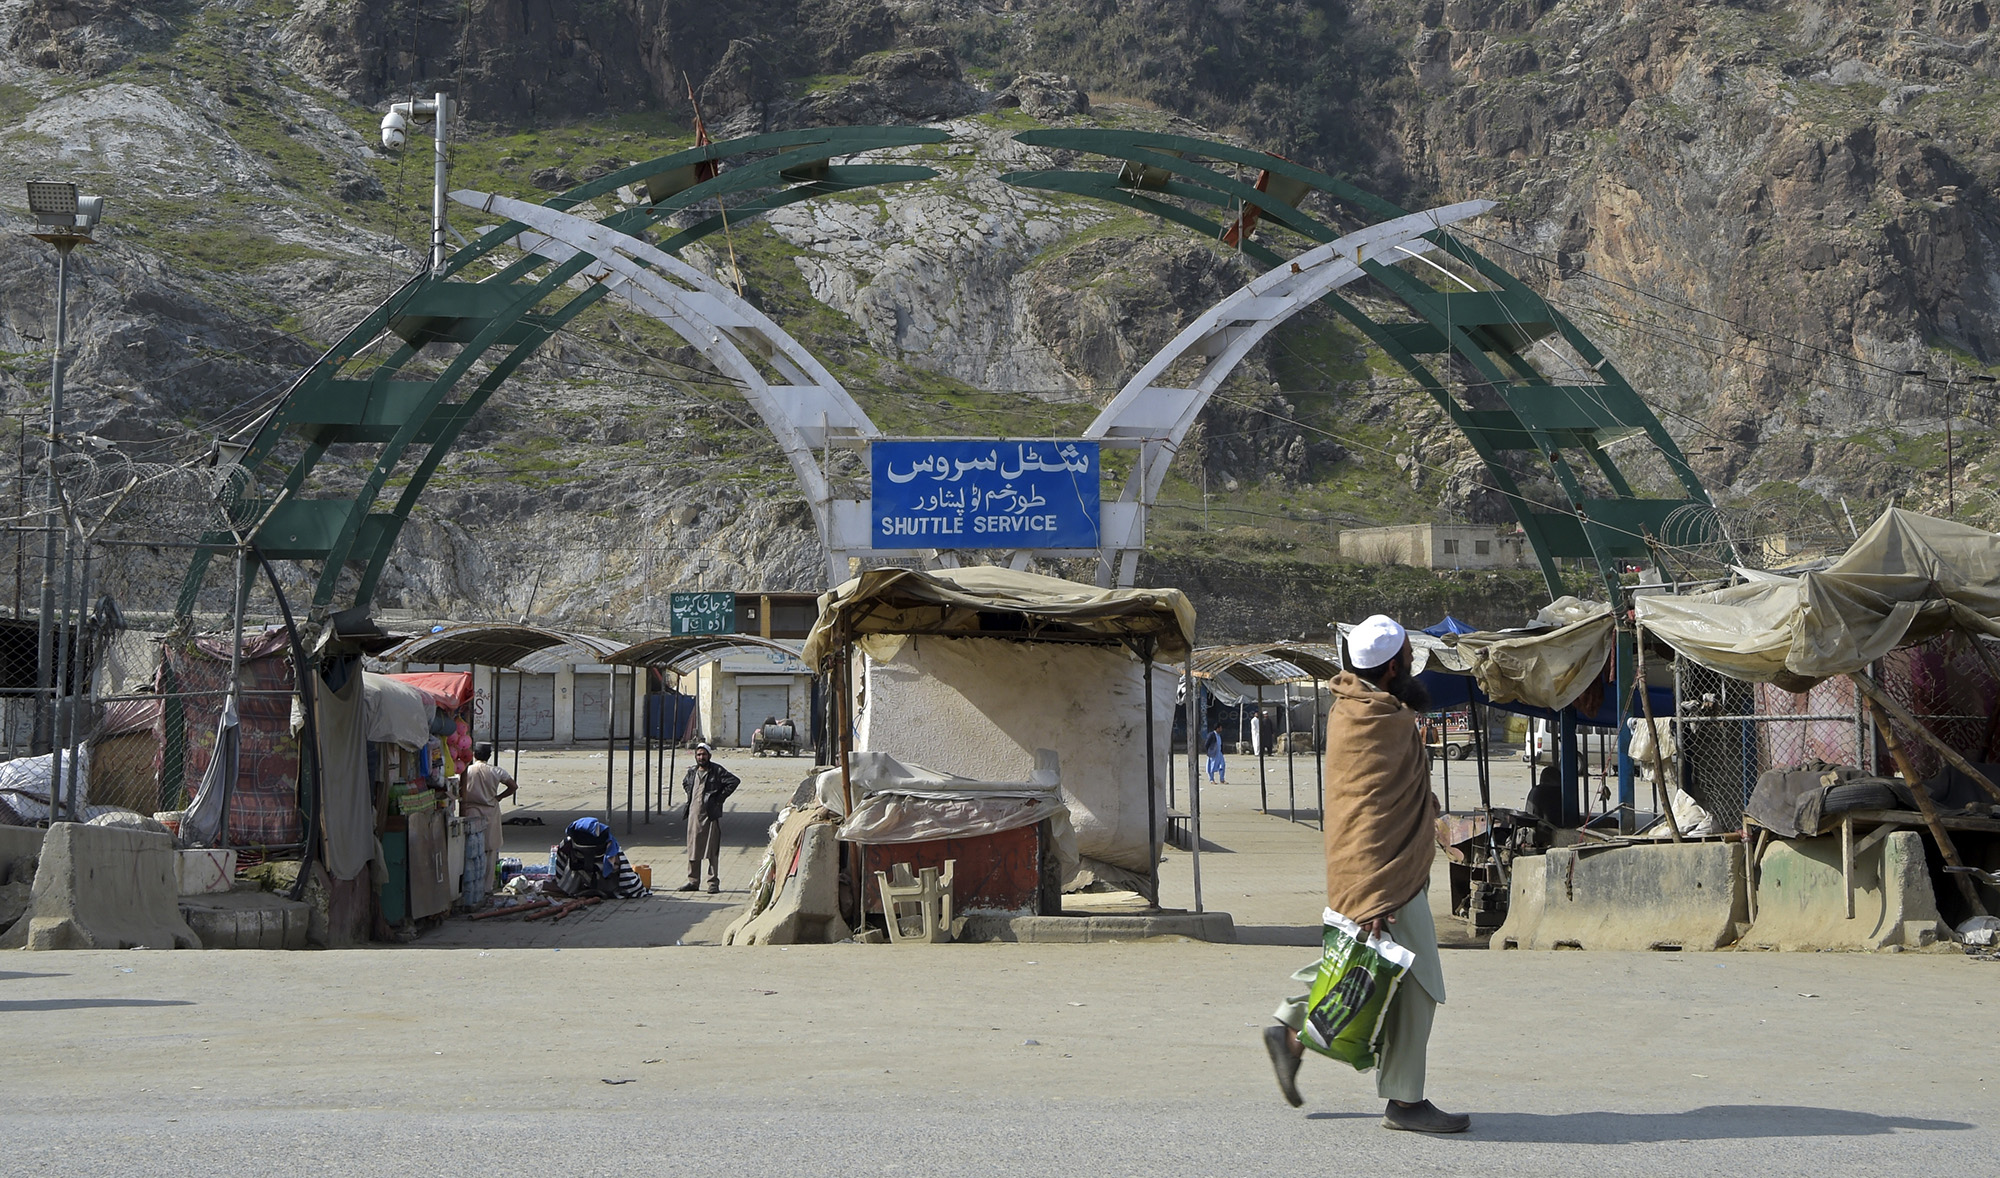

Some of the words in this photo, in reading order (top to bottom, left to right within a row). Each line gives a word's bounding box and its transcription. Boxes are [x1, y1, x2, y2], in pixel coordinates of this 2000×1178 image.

[887, 448, 998, 484] سروس
[1000, 443, 1090, 480] شٹل
[910, 486, 966, 517] پشاور
[986, 483, 1046, 515] طورخم
[881, 516, 964, 536] SHUTTLE
[973, 514, 1058, 534] SERVICE
